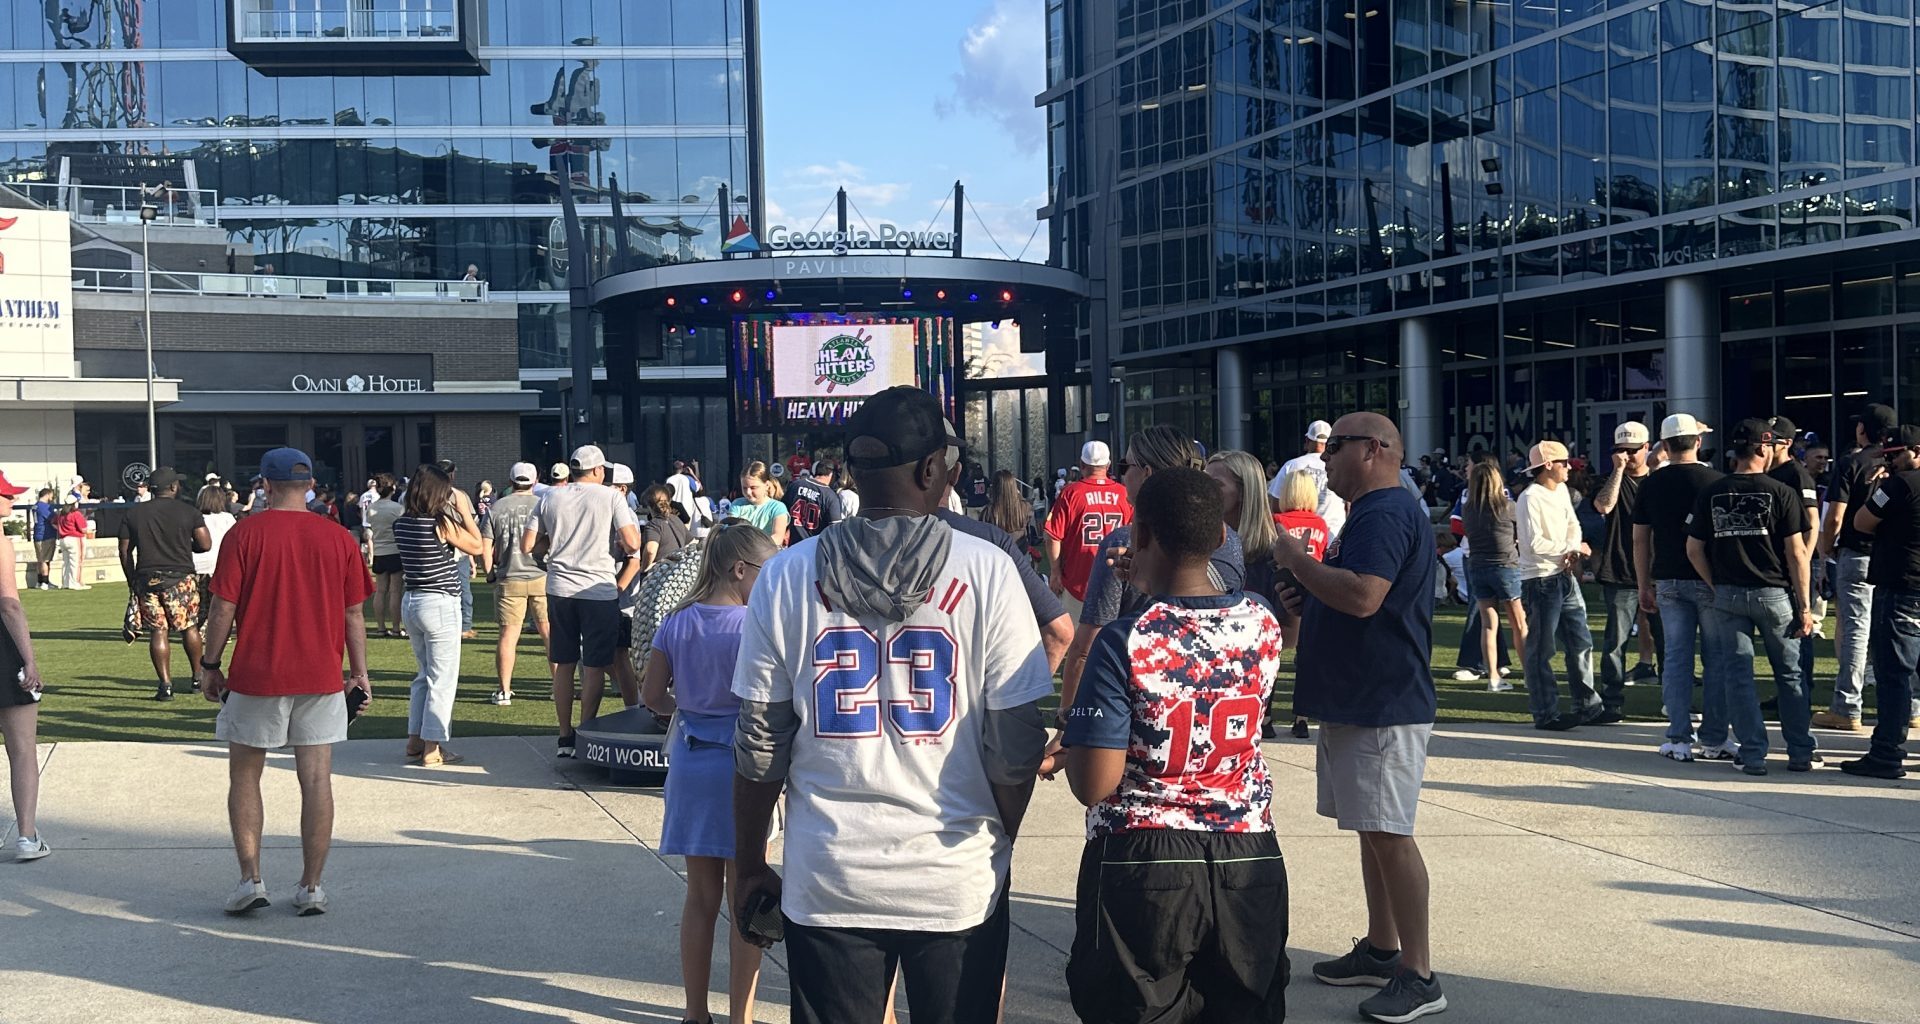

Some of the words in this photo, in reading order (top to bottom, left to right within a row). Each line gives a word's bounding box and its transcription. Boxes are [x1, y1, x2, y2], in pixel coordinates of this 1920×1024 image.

[768, 224, 870, 255] Georgia
[880, 224, 958, 250] Power
[786, 260, 891, 275] PAVILION
[0, 299, 59, 319] NTHEM
[819, 346, 869, 362] HEAVY
[815, 359, 875, 376] HITTERS
[292, 374, 341, 392] OMNI
[368, 375, 426, 392] HOTEL
[787, 402, 839, 419] HEAVY
[1085, 491, 1119, 506] RILEY
[790, 499, 820, 530] 40
[1082, 512, 1123, 547] 27
[812, 625, 959, 738] 23
[1161, 694, 1263, 790] 18
[586, 742, 610, 763] 2021
